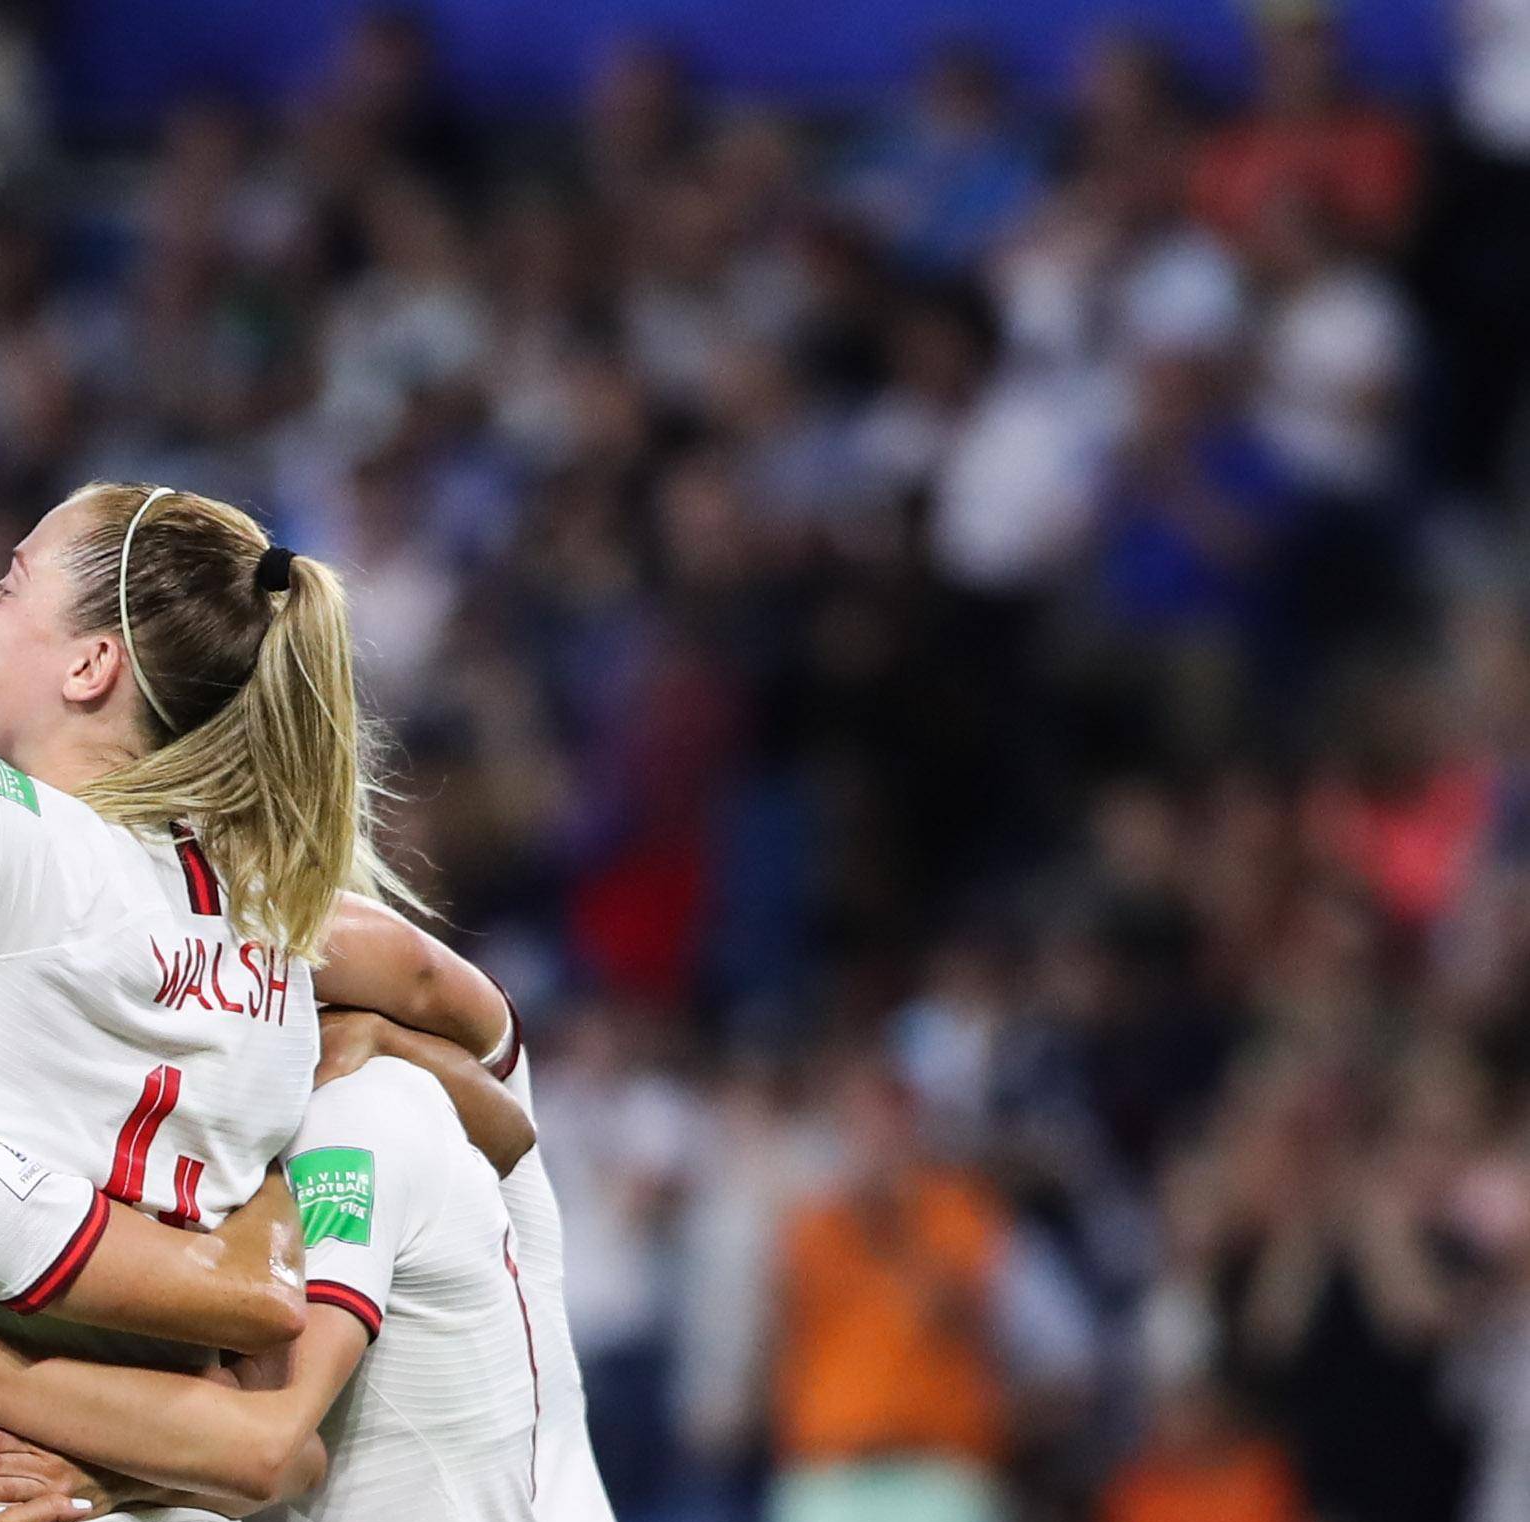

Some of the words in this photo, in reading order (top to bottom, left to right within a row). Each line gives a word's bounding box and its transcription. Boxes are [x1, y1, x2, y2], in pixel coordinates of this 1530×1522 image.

[149, 934, 291, 1027] WALSH
[102, 1063, 206, 1231] 4
[296, 1170, 369, 1189] LIVING
[297, 1182, 369, 1200] FOOTBALL
[340, 1202, 367, 1219] FIFA
